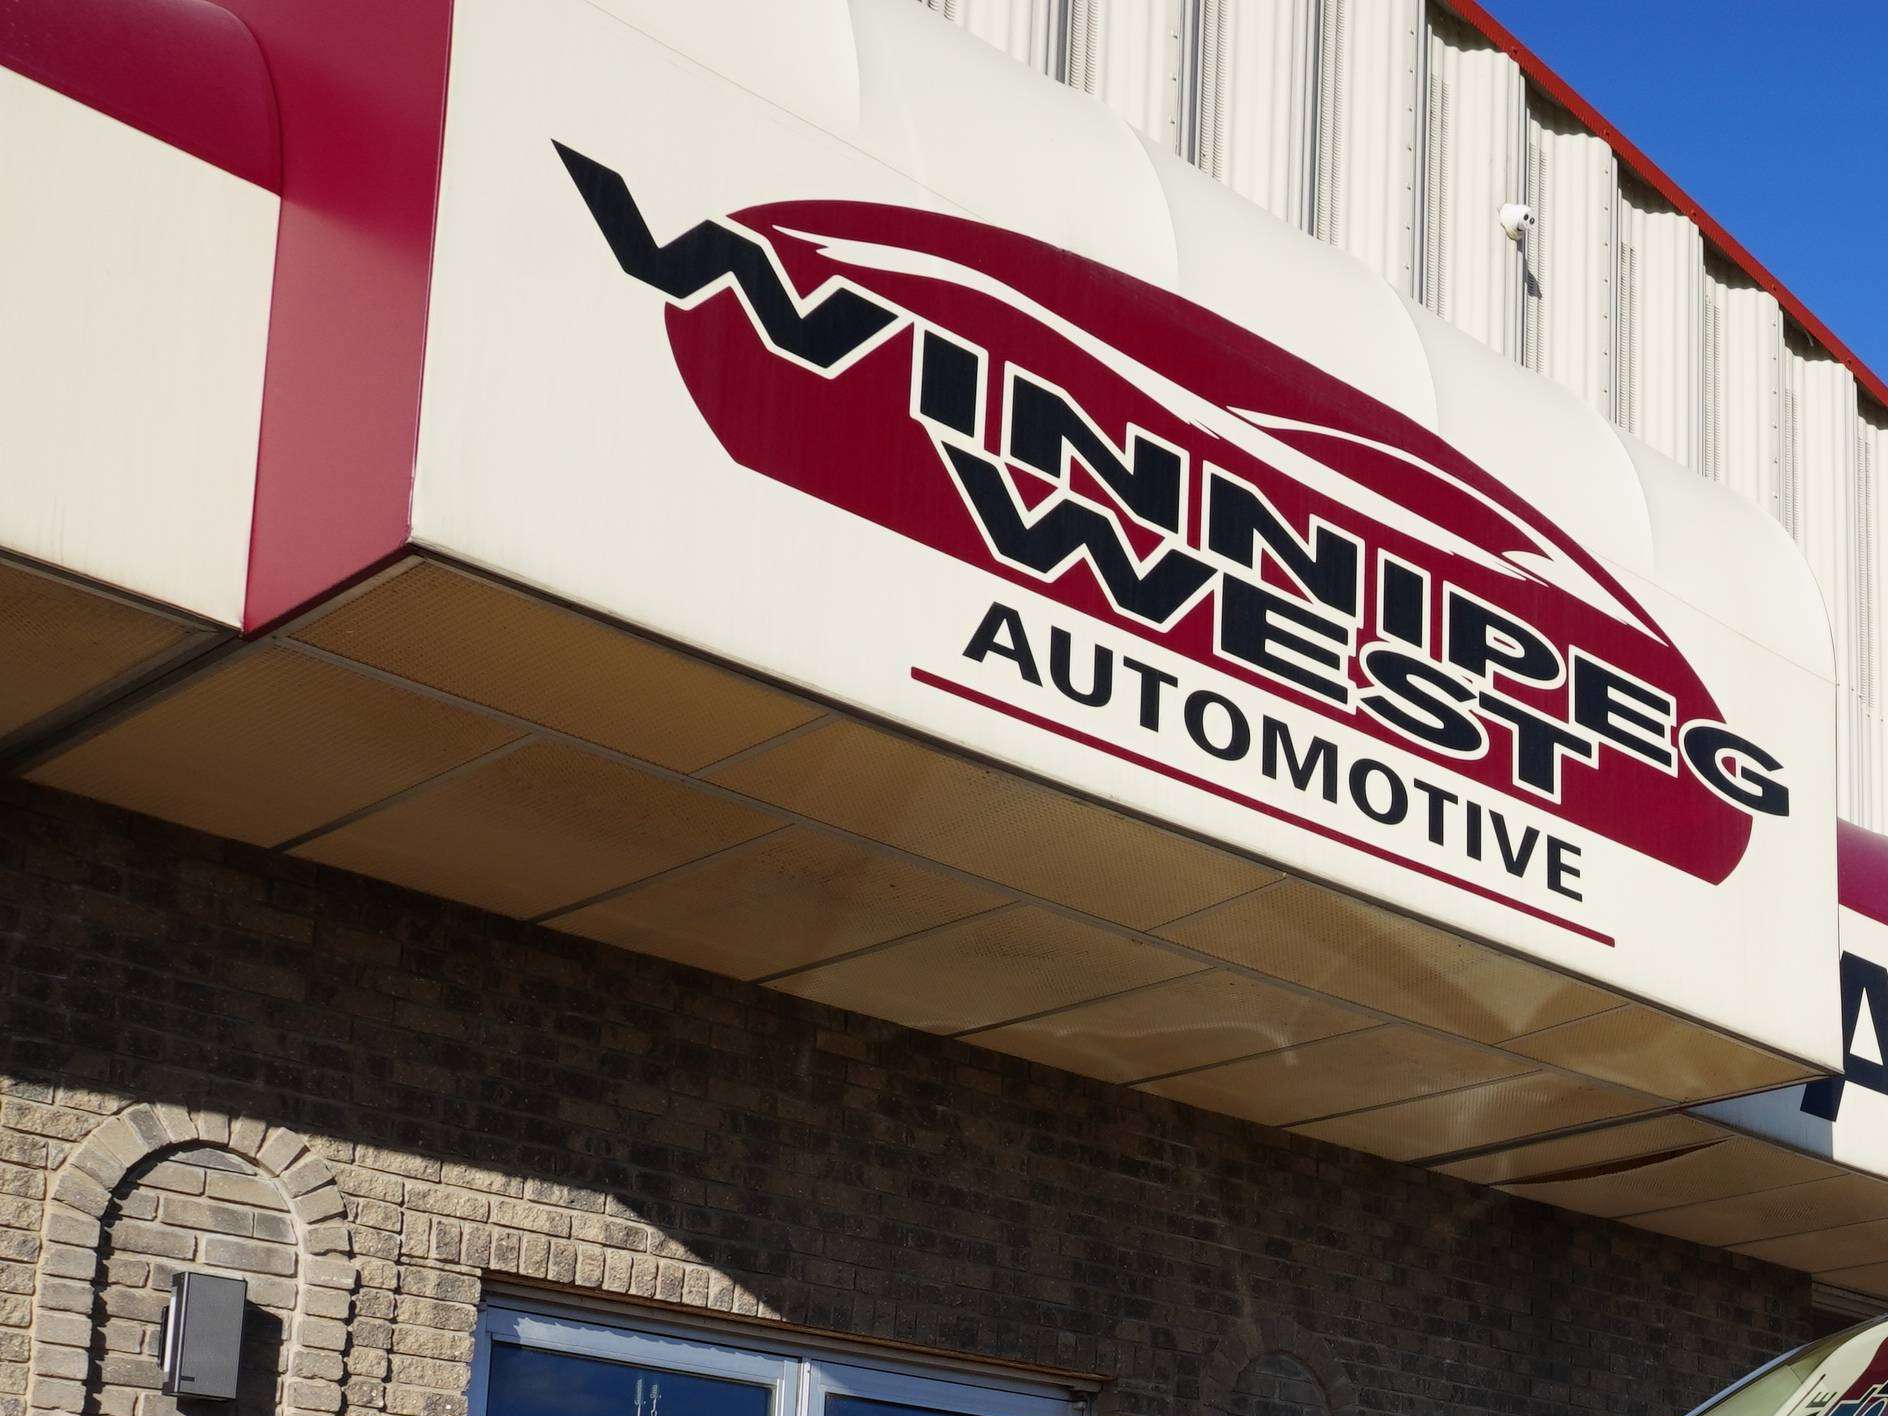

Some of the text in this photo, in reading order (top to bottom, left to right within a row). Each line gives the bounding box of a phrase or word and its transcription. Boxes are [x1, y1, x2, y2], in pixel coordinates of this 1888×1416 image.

[551, 139, 1789, 817] WINNIPEG
[942, 440, 1595, 798] WEST
[963, 602, 1584, 903] AUTOMOTIVE
